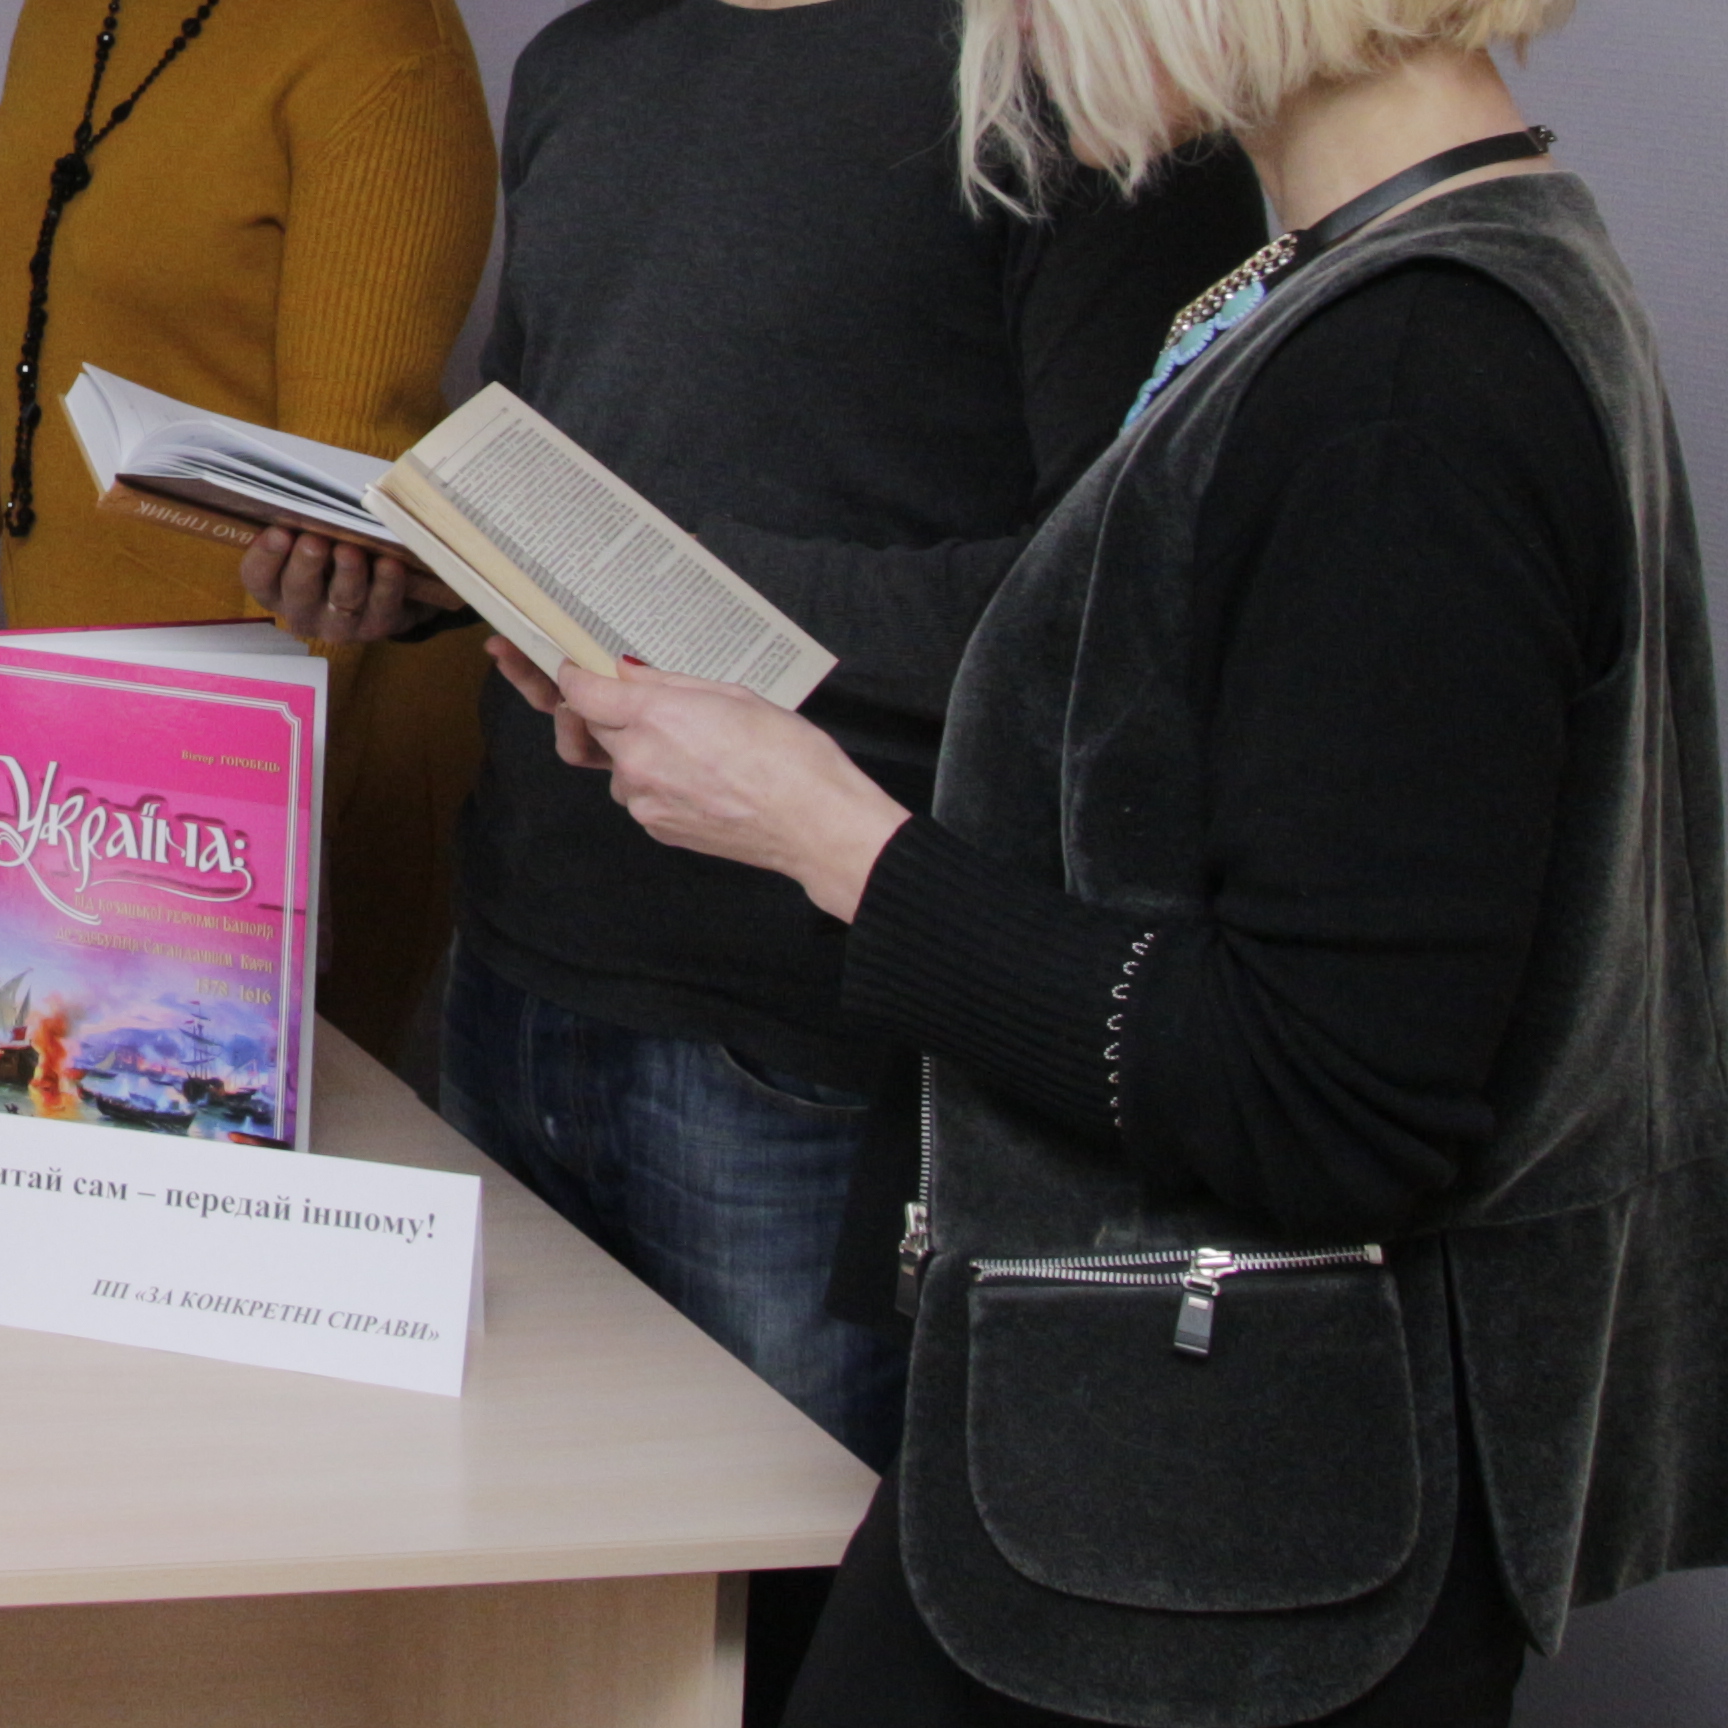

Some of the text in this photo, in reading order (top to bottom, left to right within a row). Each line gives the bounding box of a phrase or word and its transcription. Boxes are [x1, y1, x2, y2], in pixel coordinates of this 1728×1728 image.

[212, 523, 255, 545] ВЛО
[181, 750, 281, 773] Віктор ГОРОБЕЦЬ
[73, 1176, 128, 1201] сам
[165, 1187, 292, 1222] передай
[302, 1198, 436, 1244] іншому!
[91, 1279, 440, 1342] ПП «ЗА КОНКРЕТНІ СПРАВИ»
